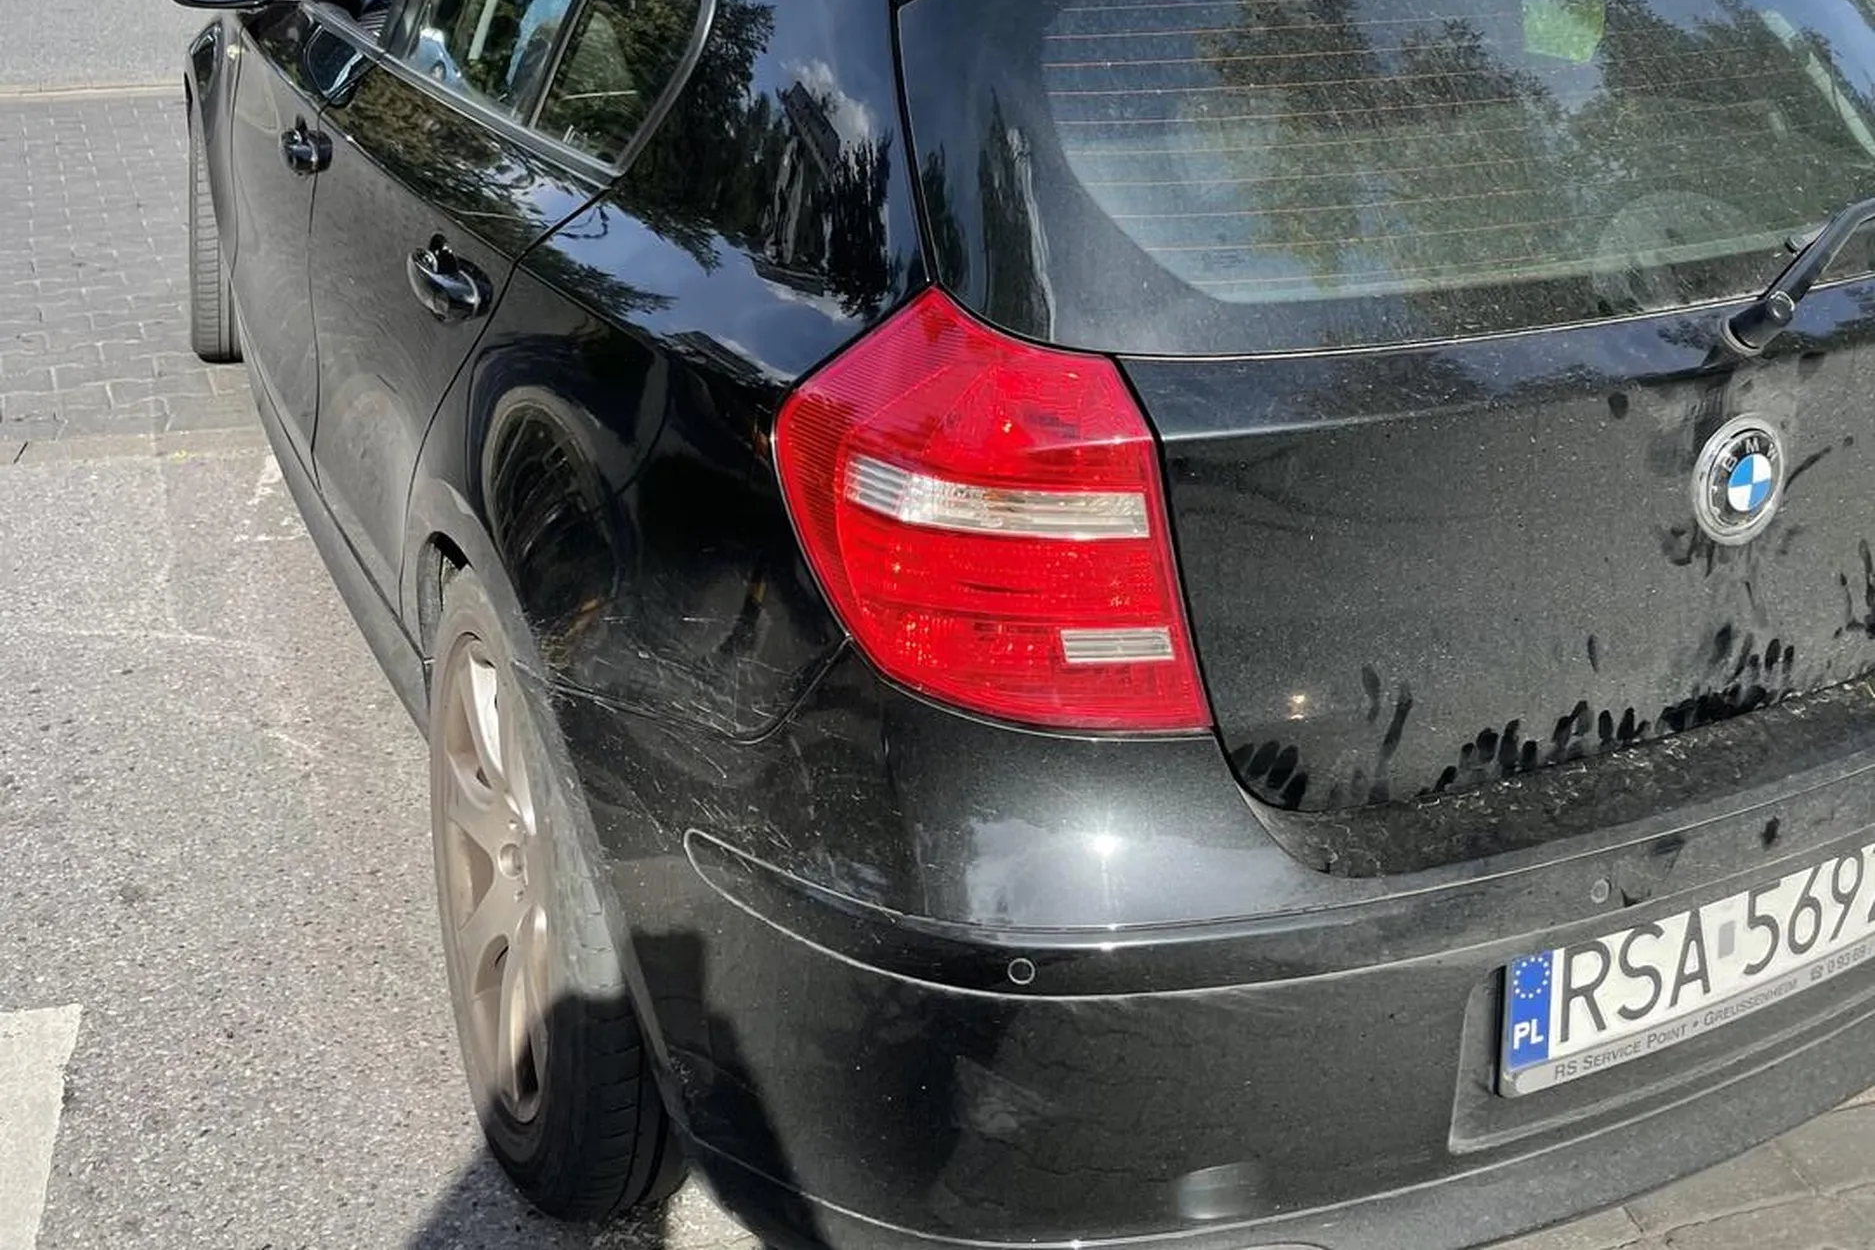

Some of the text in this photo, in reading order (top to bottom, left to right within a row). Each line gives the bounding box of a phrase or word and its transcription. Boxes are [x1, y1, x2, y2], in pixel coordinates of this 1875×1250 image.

[1720, 437, 1779, 473] BMW
[1559, 911, 1711, 1044] RSA
[1512, 1019, 1544, 1050] PL
[1554, 1060, 1578, 1081] RS
[1583, 1041, 1642, 1070] SERVICE
[1647, 1025, 1687, 1049] POINT
